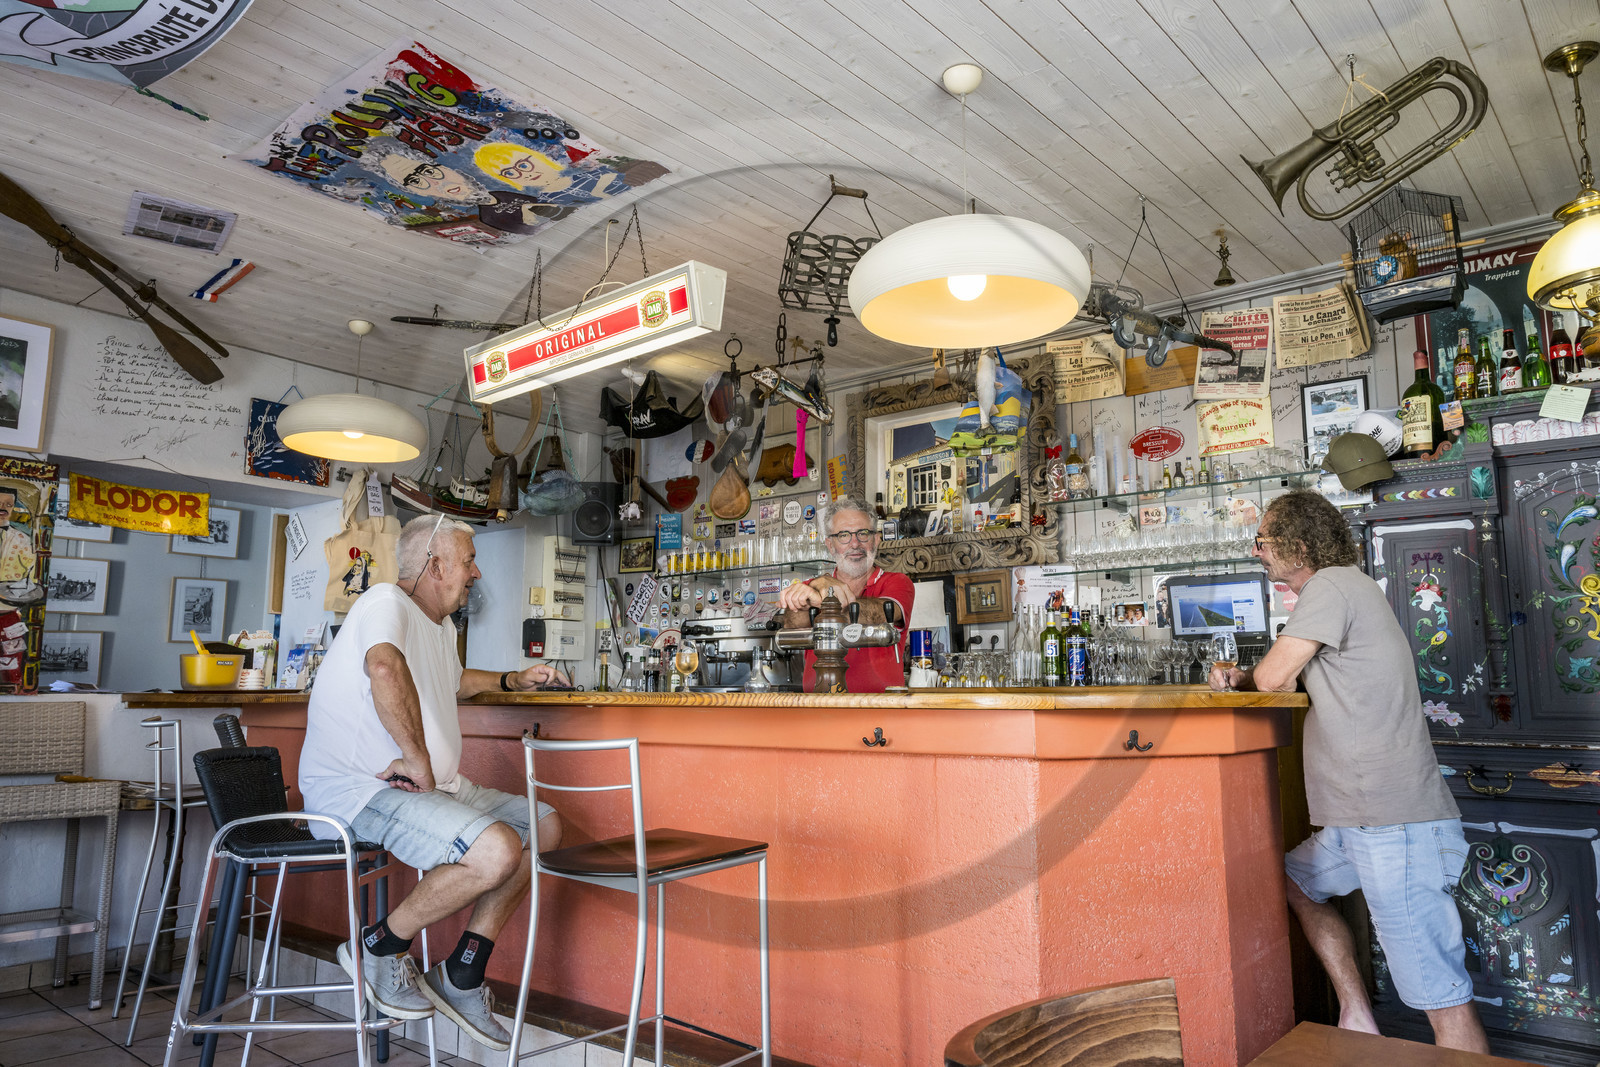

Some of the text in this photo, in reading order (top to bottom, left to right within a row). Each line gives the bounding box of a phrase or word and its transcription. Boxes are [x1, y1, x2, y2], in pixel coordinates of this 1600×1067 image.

[67, 3, 209, 61] PRINCIPAUTÉ
[259, 72, 458, 181] THE ROLLING
[397, 110, 493, 158] FISH
[1485, 269, 1520, 281] Trappiste
[647, 303, 660, 315] DAB
[1303, 307, 1346, 323] Le Canard
[535, 321, 606, 358] ORIGINAL
[1320, 332, 1336, 340] Pen,
[568, 350, 584, 360] GERMAN
[584, 345, 595, 354] BEER
[491, 362, 502, 372] DAB
[1240, 400, 1264, 411] TOURAINE
[76, 476, 203, 519] FLODOR
[1047, 644, 1058, 656] 51
[461, 938, 479, 964] SOCKS
